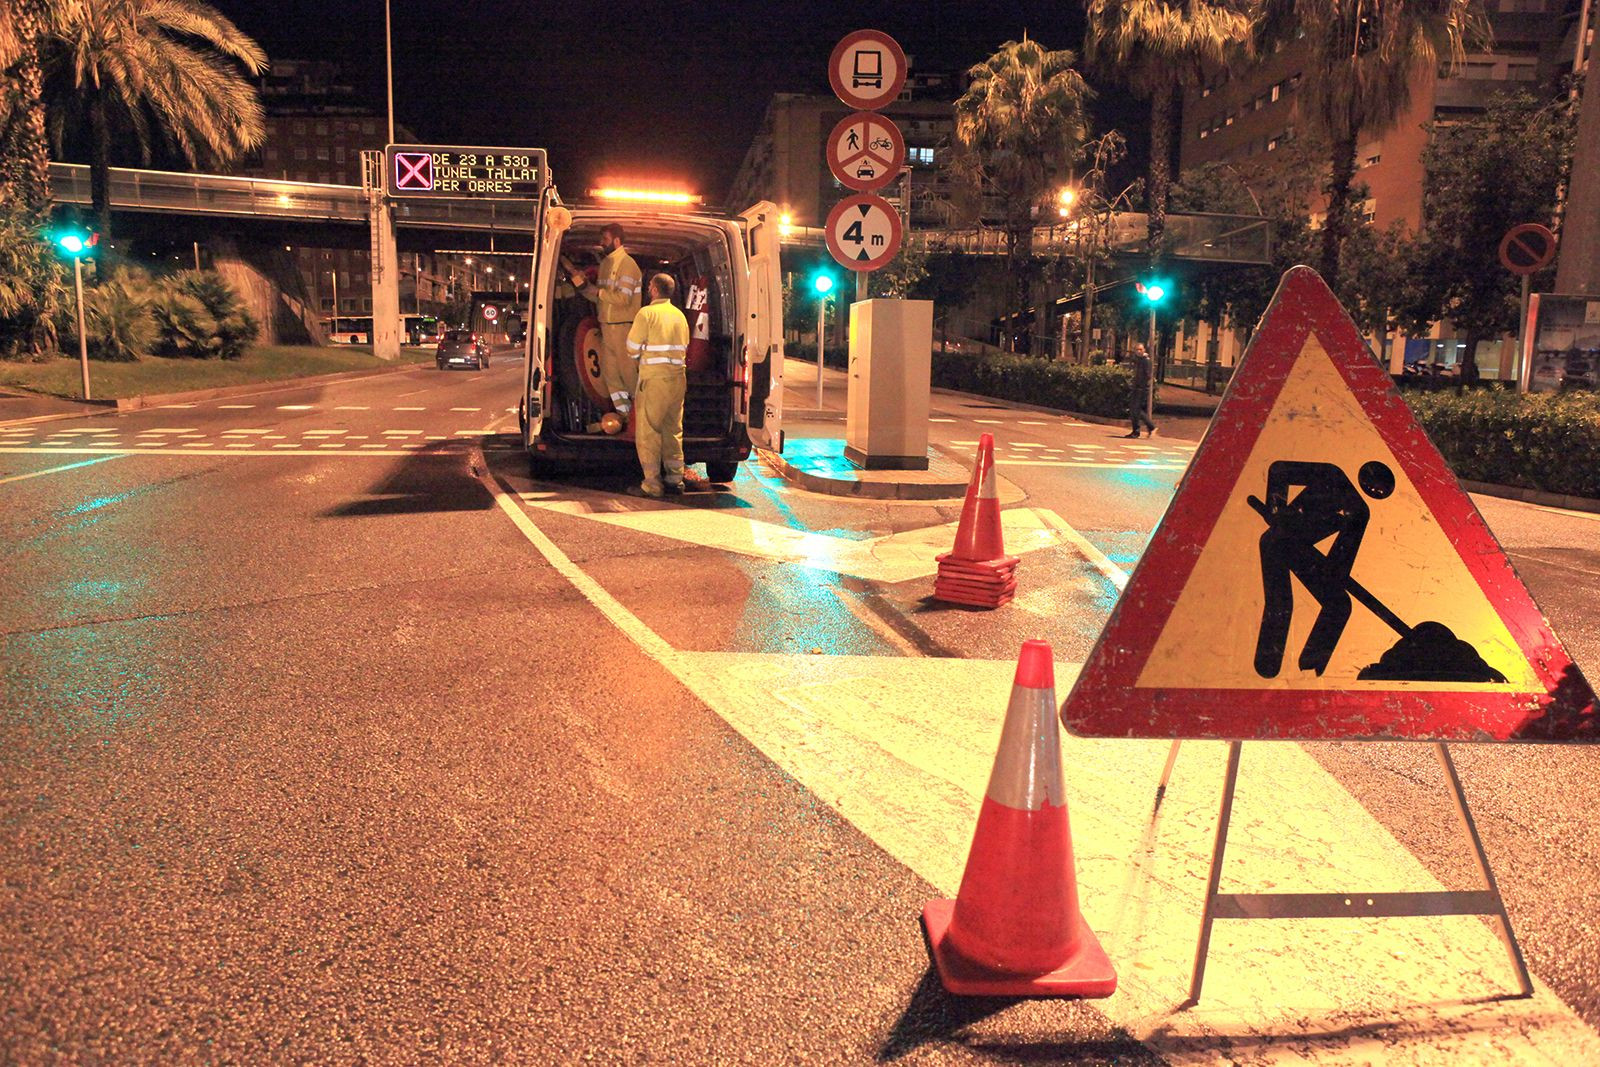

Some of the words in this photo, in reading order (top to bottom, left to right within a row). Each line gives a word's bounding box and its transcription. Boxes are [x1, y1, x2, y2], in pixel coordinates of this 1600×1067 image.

[432, 153, 450, 165] DE
[459, 154, 477, 166] 23
[485, 155, 494, 166] A
[503, 155, 529, 167] 530
[433, 166, 477, 179] TUNEL
[486, 168, 538, 180] TALLAT
[433, 180, 460, 191] PER
[468, 181, 512, 192] OBRES
[843, 220, 864, 245] 4
[871, 234, 884, 246] m
